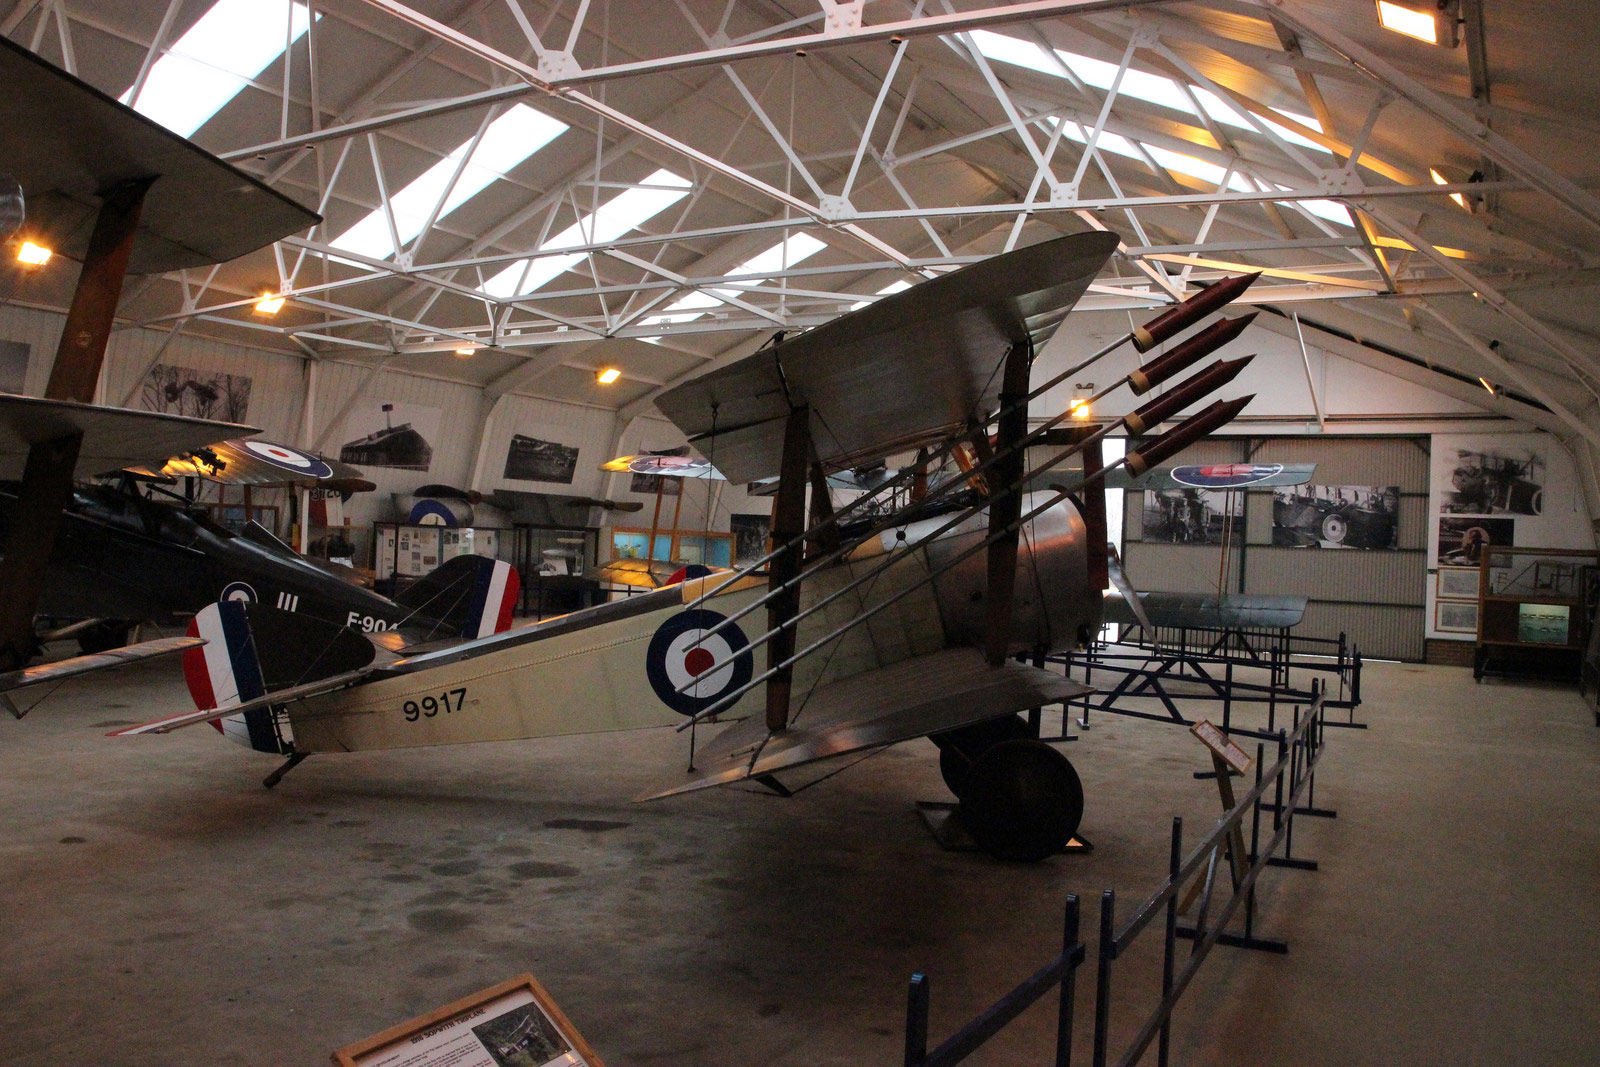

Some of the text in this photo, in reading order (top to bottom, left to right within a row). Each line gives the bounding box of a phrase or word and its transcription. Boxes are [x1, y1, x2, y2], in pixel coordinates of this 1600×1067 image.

[403, 687, 467, 722] 9917
[424, 1021, 456, 1039] SOPWITH
[454, 1008, 487, 1025] TRIPLANE
